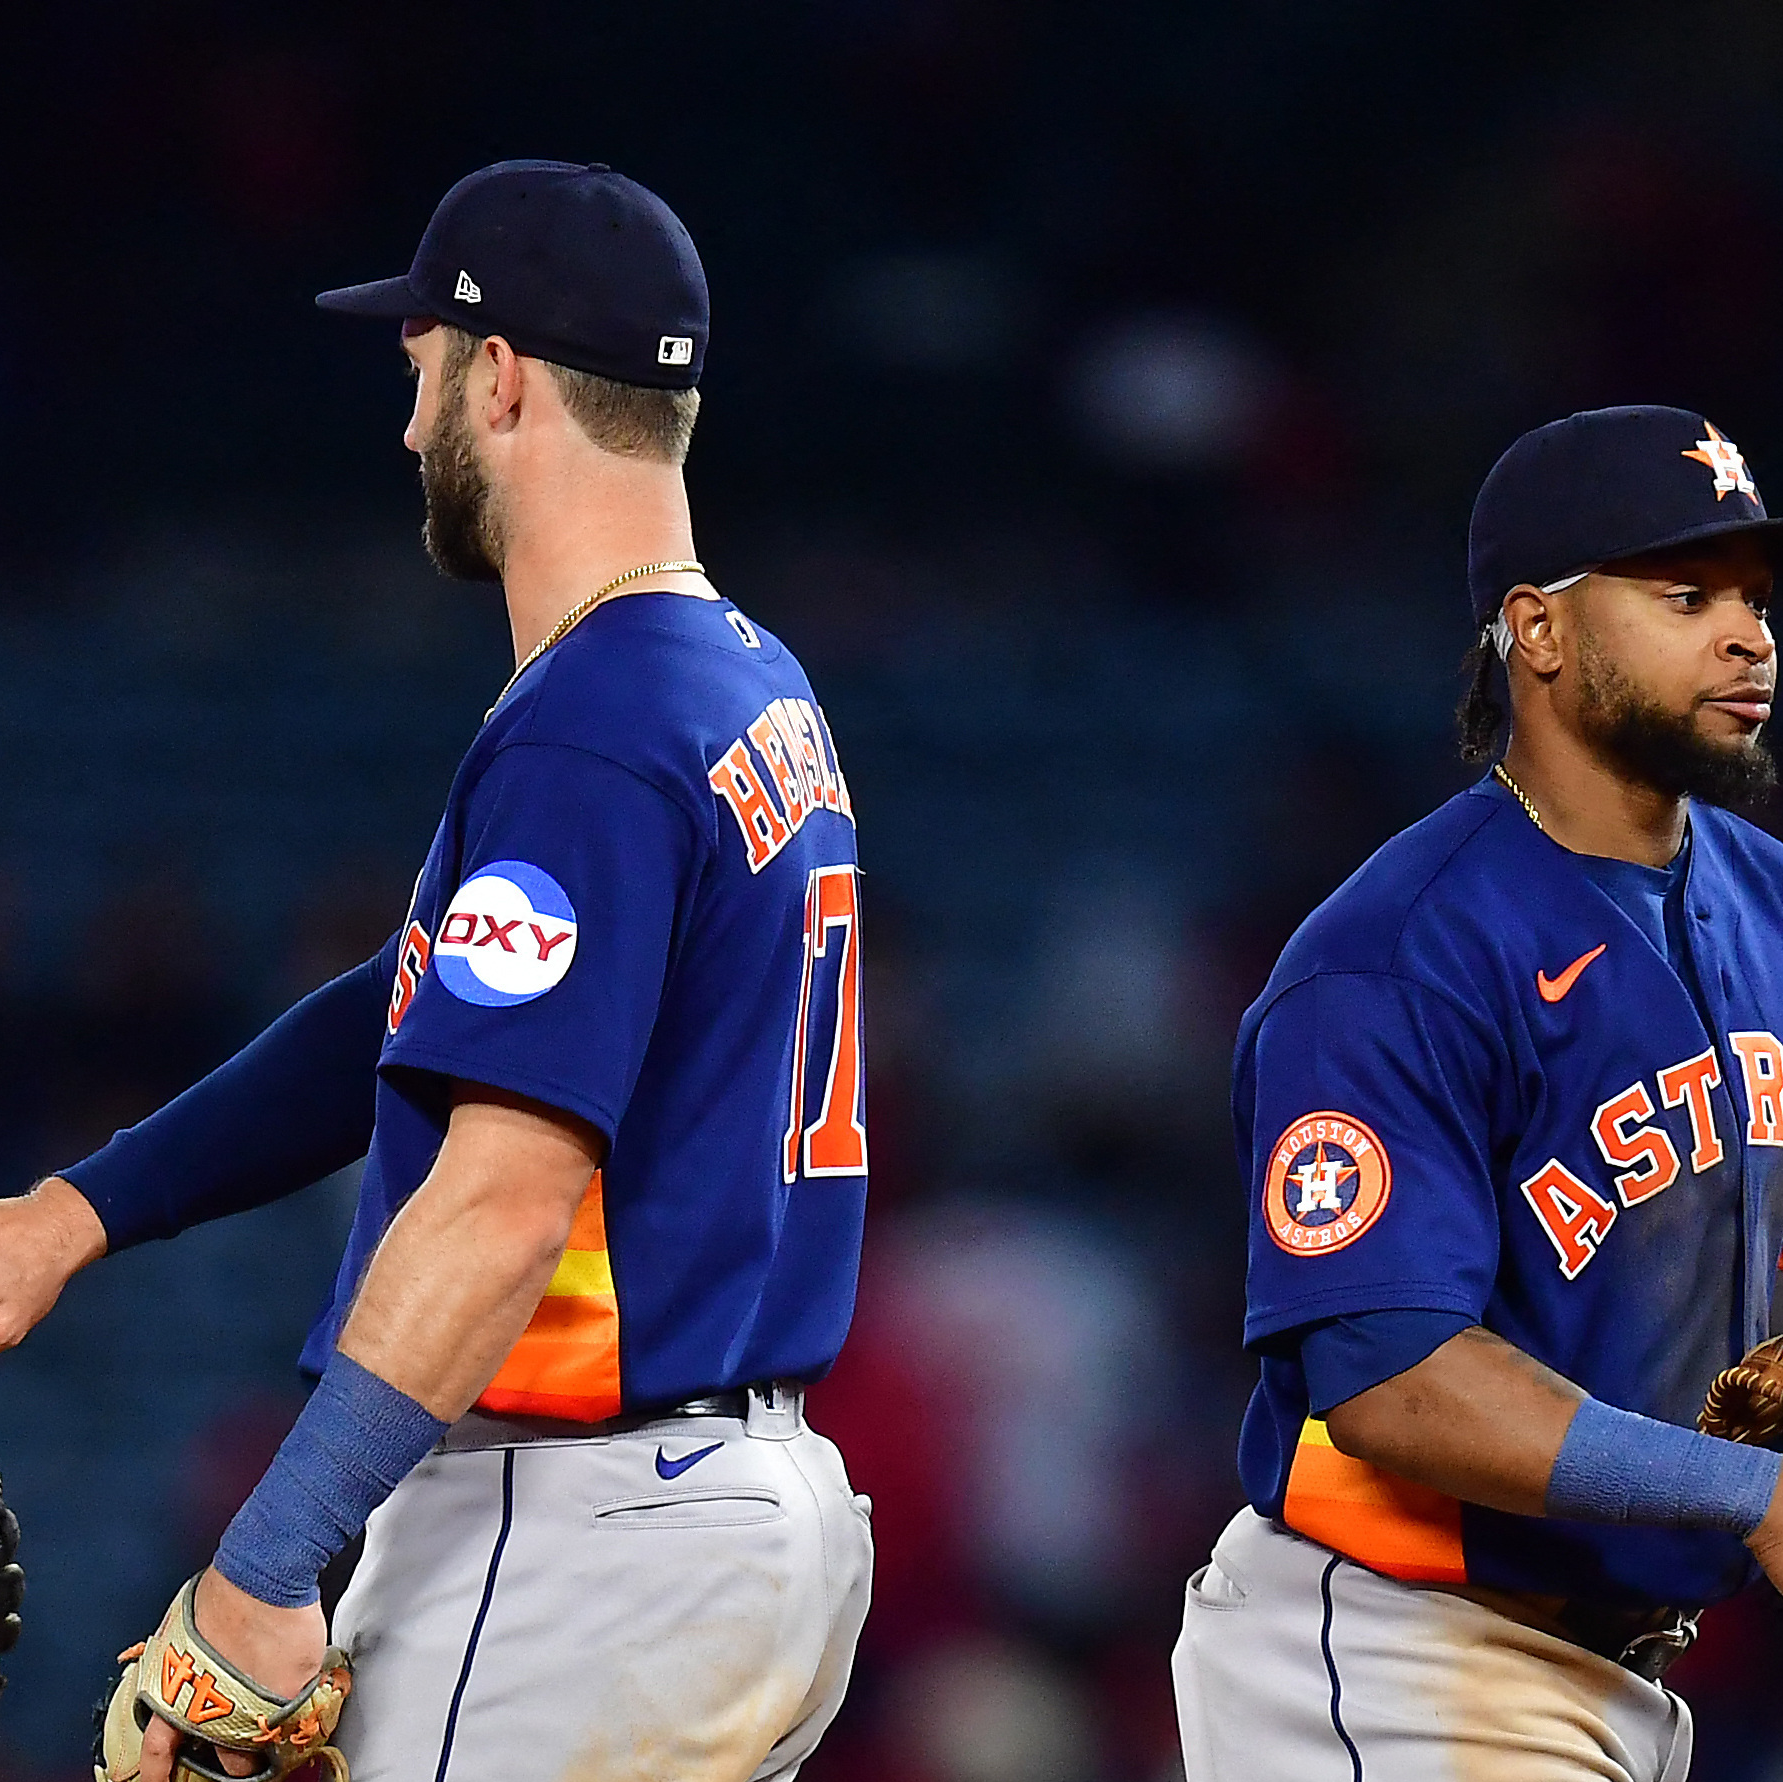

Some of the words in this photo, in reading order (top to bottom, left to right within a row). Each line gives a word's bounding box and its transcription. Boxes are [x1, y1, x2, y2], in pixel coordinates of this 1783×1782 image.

[1696, 440, 1755, 493] H
[440, 913, 573, 962] OXY
[783, 864, 868, 1184] 17
[1277, 1121, 1373, 1167] HOUSTON
[1296, 1160, 1344, 1212] H
[1279, 1211, 1364, 1248] ASTROS
